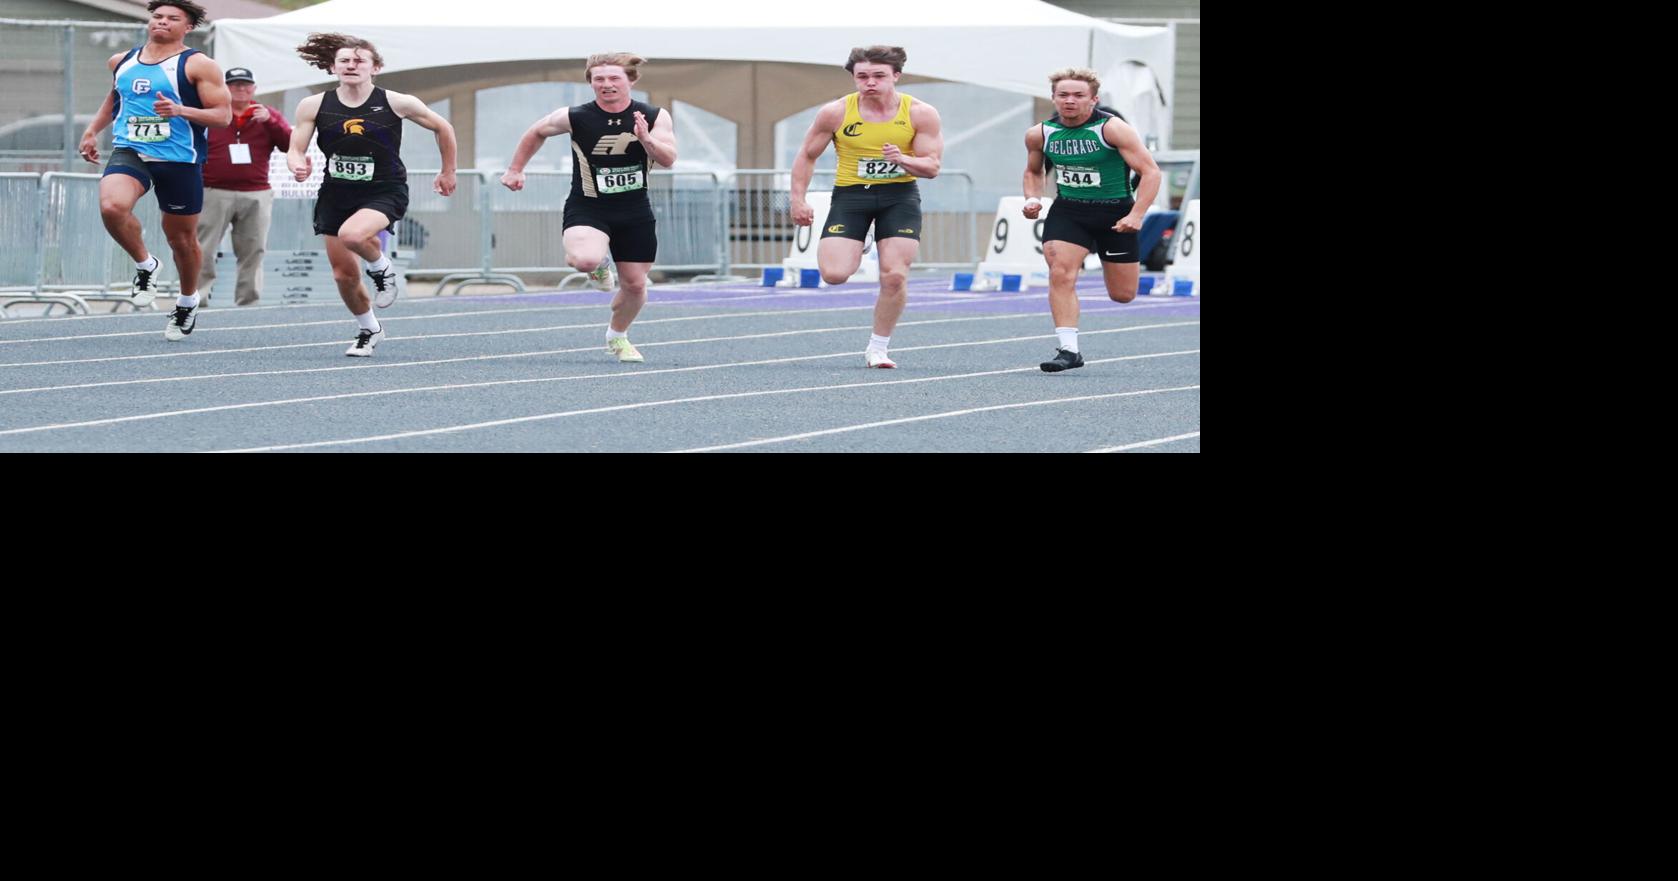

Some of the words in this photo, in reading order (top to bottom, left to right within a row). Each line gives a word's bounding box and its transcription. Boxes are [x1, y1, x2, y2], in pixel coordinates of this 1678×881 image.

[133, 124, 162, 137] 771
[843, 121, 863, 137] C
[1049, 139, 1100, 155] BELGRADE
[335, 162, 367, 176] 893
[866, 162, 898, 175] 822
[604, 173, 637, 188] 605
[1062, 171, 1093, 185] 544
[828, 223, 845, 234] C
[994, 217, 1008, 254] 9
[1181, 221, 1194, 257] 8
